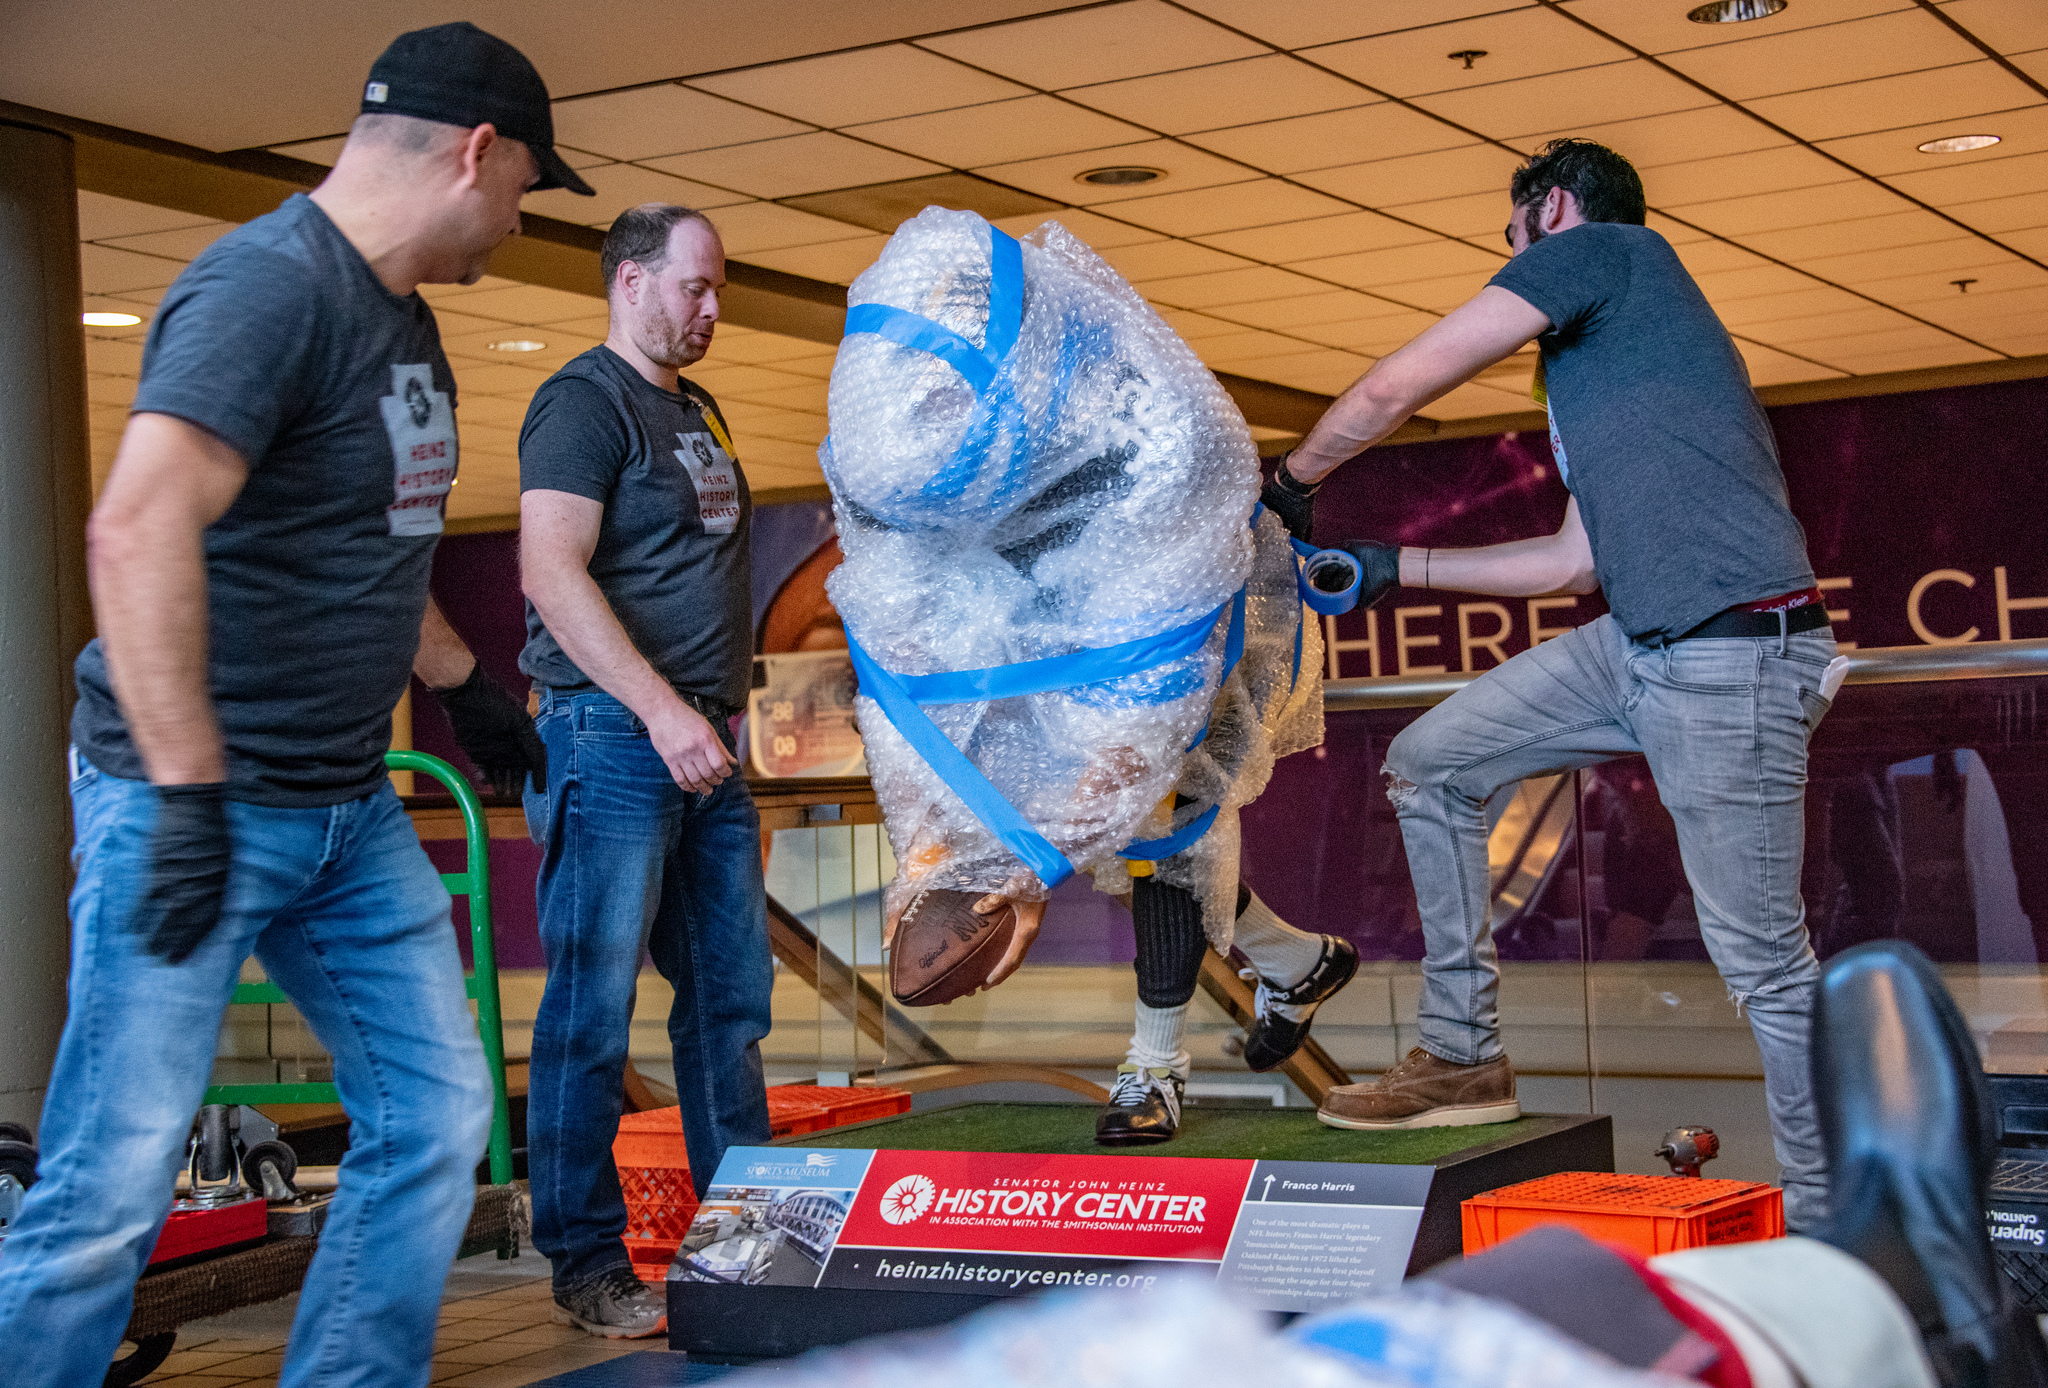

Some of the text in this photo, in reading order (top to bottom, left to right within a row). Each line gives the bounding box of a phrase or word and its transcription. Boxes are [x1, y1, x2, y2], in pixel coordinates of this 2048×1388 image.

[701, 474, 729, 485] HEINZ
[700, 490, 736, 502] HISTORY
[1788, 594, 1809, 609] Klein
[919, 939, 948, 968] Official
[745, 1165, 831, 1177] SPORTS MUSEUM
[993, 1178, 1166, 1191] SENATOR JOHN HEINZ
[1282, 1180, 1355, 1192] Franco Harris
[934, 1188, 1207, 1222] HISTORY CENTER
[1990, 1210, 2038, 1224] CANTON,
[929, 1216, 1204, 1234] IN ASSOCIATION WITH THE SMITHSONIAN INSTITUTION
[1269, 1219, 1278, 1227] of
[1309, 1221, 1341, 1229] dramatic
[1342, 1222, 1361, 1230] plays
[1293, 1231, 1318, 1239] Franco
[1345, 1233, 1382, 1243] legendary
[1986, 1223, 2047, 1245] Superi
[1329, 1244, 1355, 1253] against
[1355, 1245, 1368, 1253] the
[1241, 1251, 1362, 1264] Oakland Raiders in 1972 lifted the
[1238, 1262, 1274, 1272] Pittsburgh
[1275, 1264, 1302, 1273] Steelers
[1313, 1266, 1331, 1274] their
[1331, 1267, 1347, 1275] first
[1348, 1268, 1376, 1276] playoff
[875, 1258, 1157, 1294] heinzhistorycenter.org
[1261, 1275, 1286, 1285] setting
[1286, 1276, 1298, 1284] the
[1300, 1278, 1319, 1286] stage
[1319, 1278, 1331, 1286] for
[1331, 1278, 1348, 1287] four
[1348, 1279, 1372, 1288] Super
[1303, 1290, 1329, 1299] during
